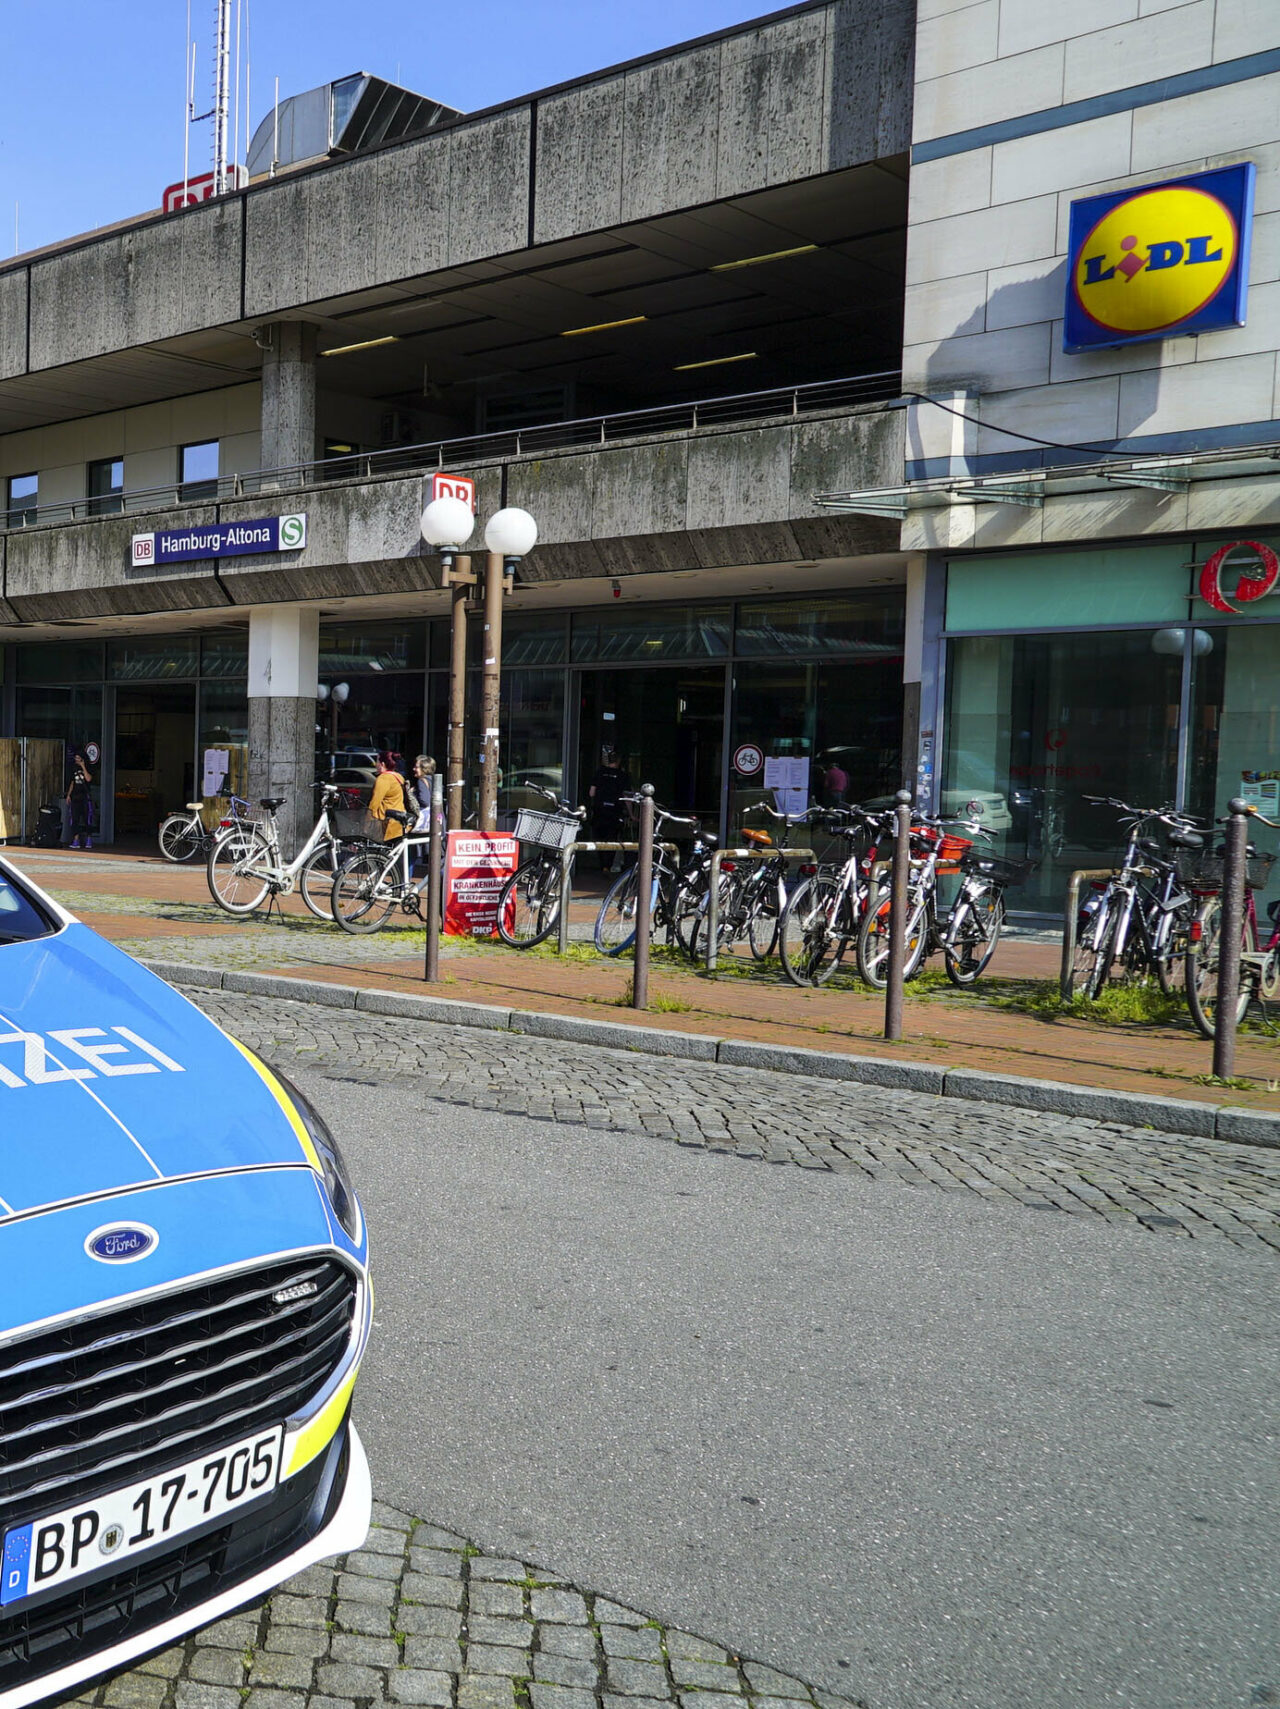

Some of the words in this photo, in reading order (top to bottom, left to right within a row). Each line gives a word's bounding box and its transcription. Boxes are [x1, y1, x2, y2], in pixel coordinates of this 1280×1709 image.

[161, 527, 271, 554] Hamburg-Altona
[135, 542, 151, 557] DB
[458, 842, 482, 853] KEIN
[484, 841, 514, 852] PROFIT
[453, 880, 508, 890] KRANKENHÄUS
[472, 926, 493, 934] DKP
[105, 1233, 141, 1254] Ford
[8, 1569, 21, 1589] D
[34, 1509, 100, 1583] BP
[128, 1434, 278, 1546] 17-705
